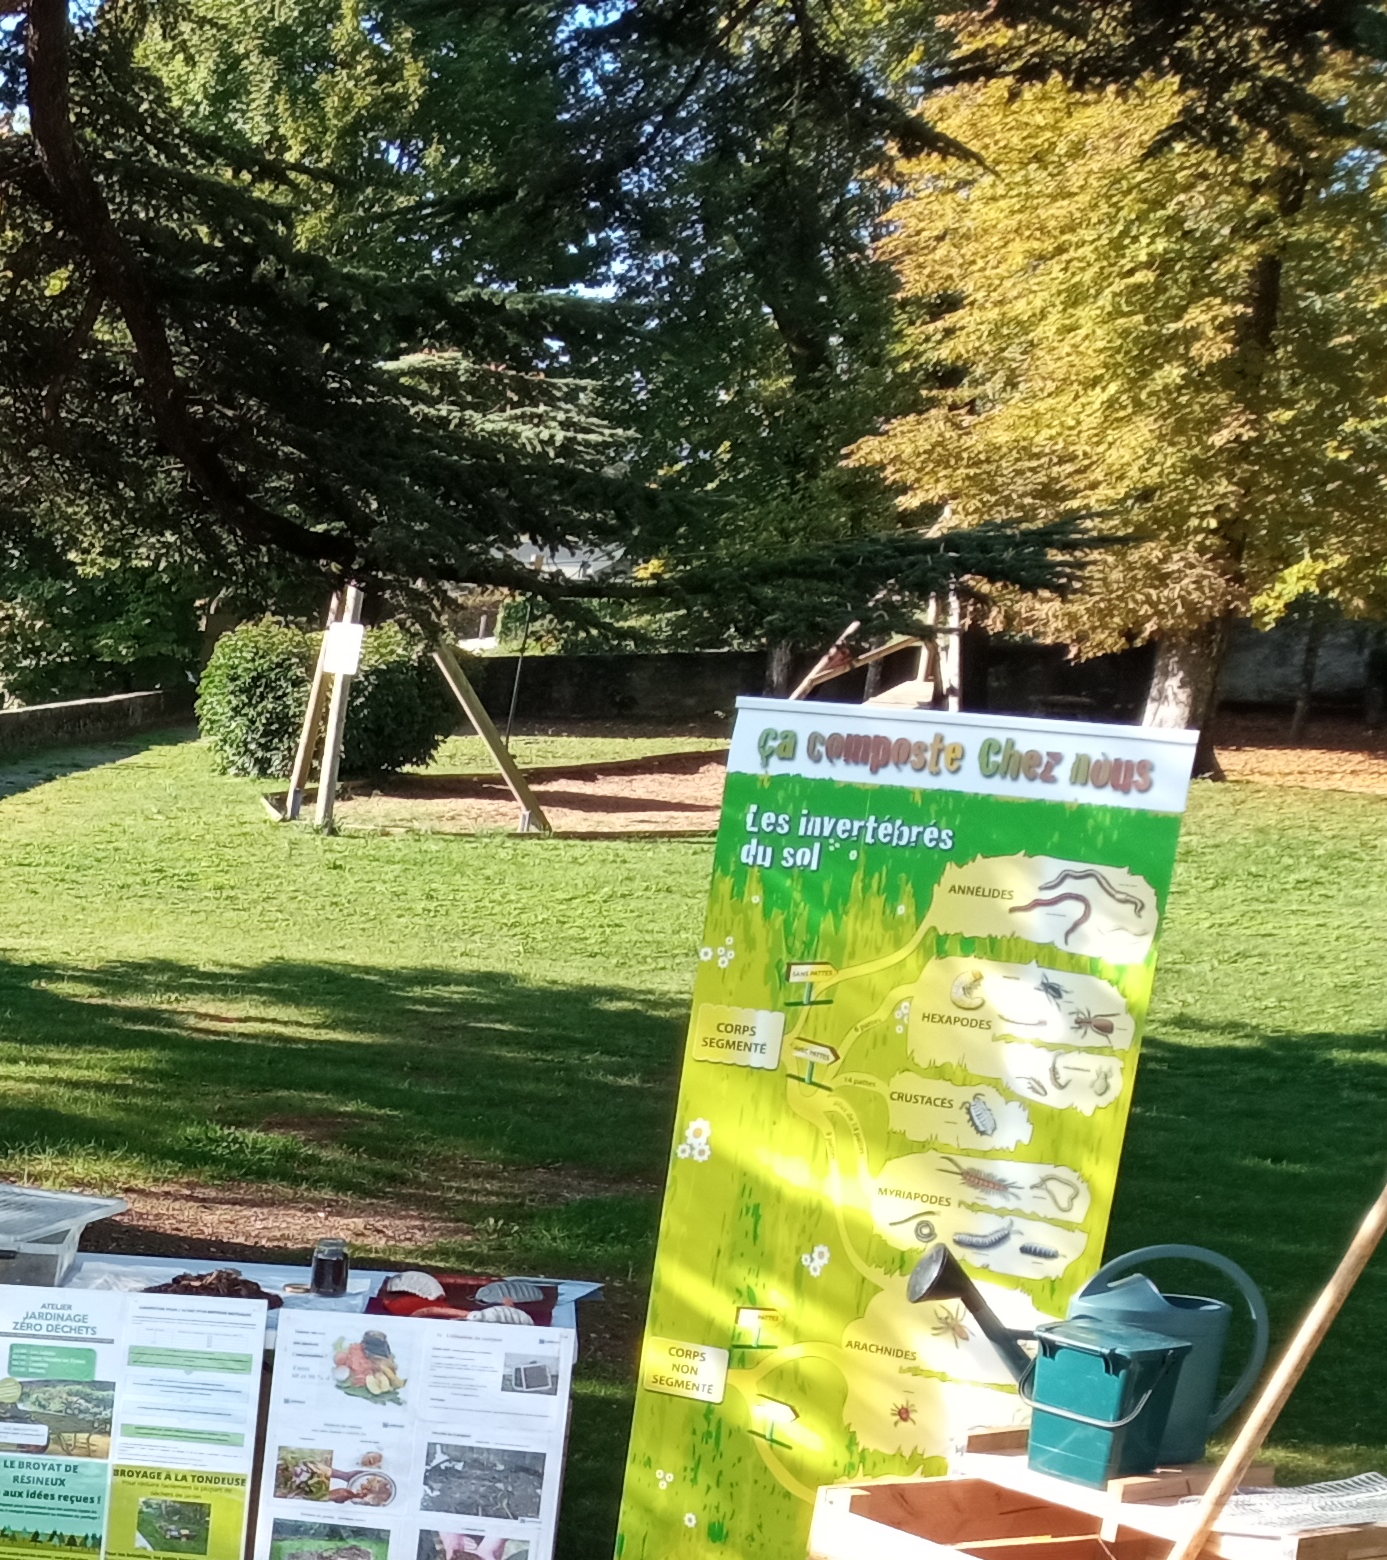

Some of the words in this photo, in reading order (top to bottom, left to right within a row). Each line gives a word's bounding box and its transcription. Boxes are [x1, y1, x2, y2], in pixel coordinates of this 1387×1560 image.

[807, 731, 965, 775] composte
[977, 736, 1062, 784] Chez
[1070, 750, 1155, 794] nous
[746, 803, 790, 835] Les
[798, 808, 955, 851] invertébrés
[740, 841, 773, 868] du
[781, 842, 821, 871] sol
[948, 884, 1014, 900] ANNÉLIDES
[810, 969, 833, 977] PATTES
[716, 1022, 757, 1036] CORPS
[921, 1012, 993, 1030] HEXAPODES
[701, 1037, 767, 1055] SEGMENTÉ
[889, 1091, 954, 1109] CRUSTACÉS
[878, 1187, 952, 1207] MYRIAPODES
[40, 1303, 73, 1311] ATELIER
[22, 1311, 89, 1324] JARDINAGE
[12, 1320, 43, 1332] ZÉRO
[45, 1323, 98, 1336] DÉCHETS
[668, 1346, 707, 1362] CORPS
[845, 1340, 917, 1361] ARACHNIDES
[672, 1363, 699, 1376] NON
[652, 1374, 714, 1395] SEGMENTÉ
[3, 1460, 16, 1469] LE
[18, 1461, 63, 1473] BROYAT
[64, 1464, 79, 1474] DE
[12, 1474, 67, 1488] RÉSINEUX
[113, 1468, 162, 1481] BROYAGE
[174, 1472, 188, 1482] LA
[190, 1474, 247, 1487] TONDEUSE
[3, 1490, 24, 1499] aux
[26, 1490, 55, 1500] idées
[58, 1494, 95, 1505] reçues
